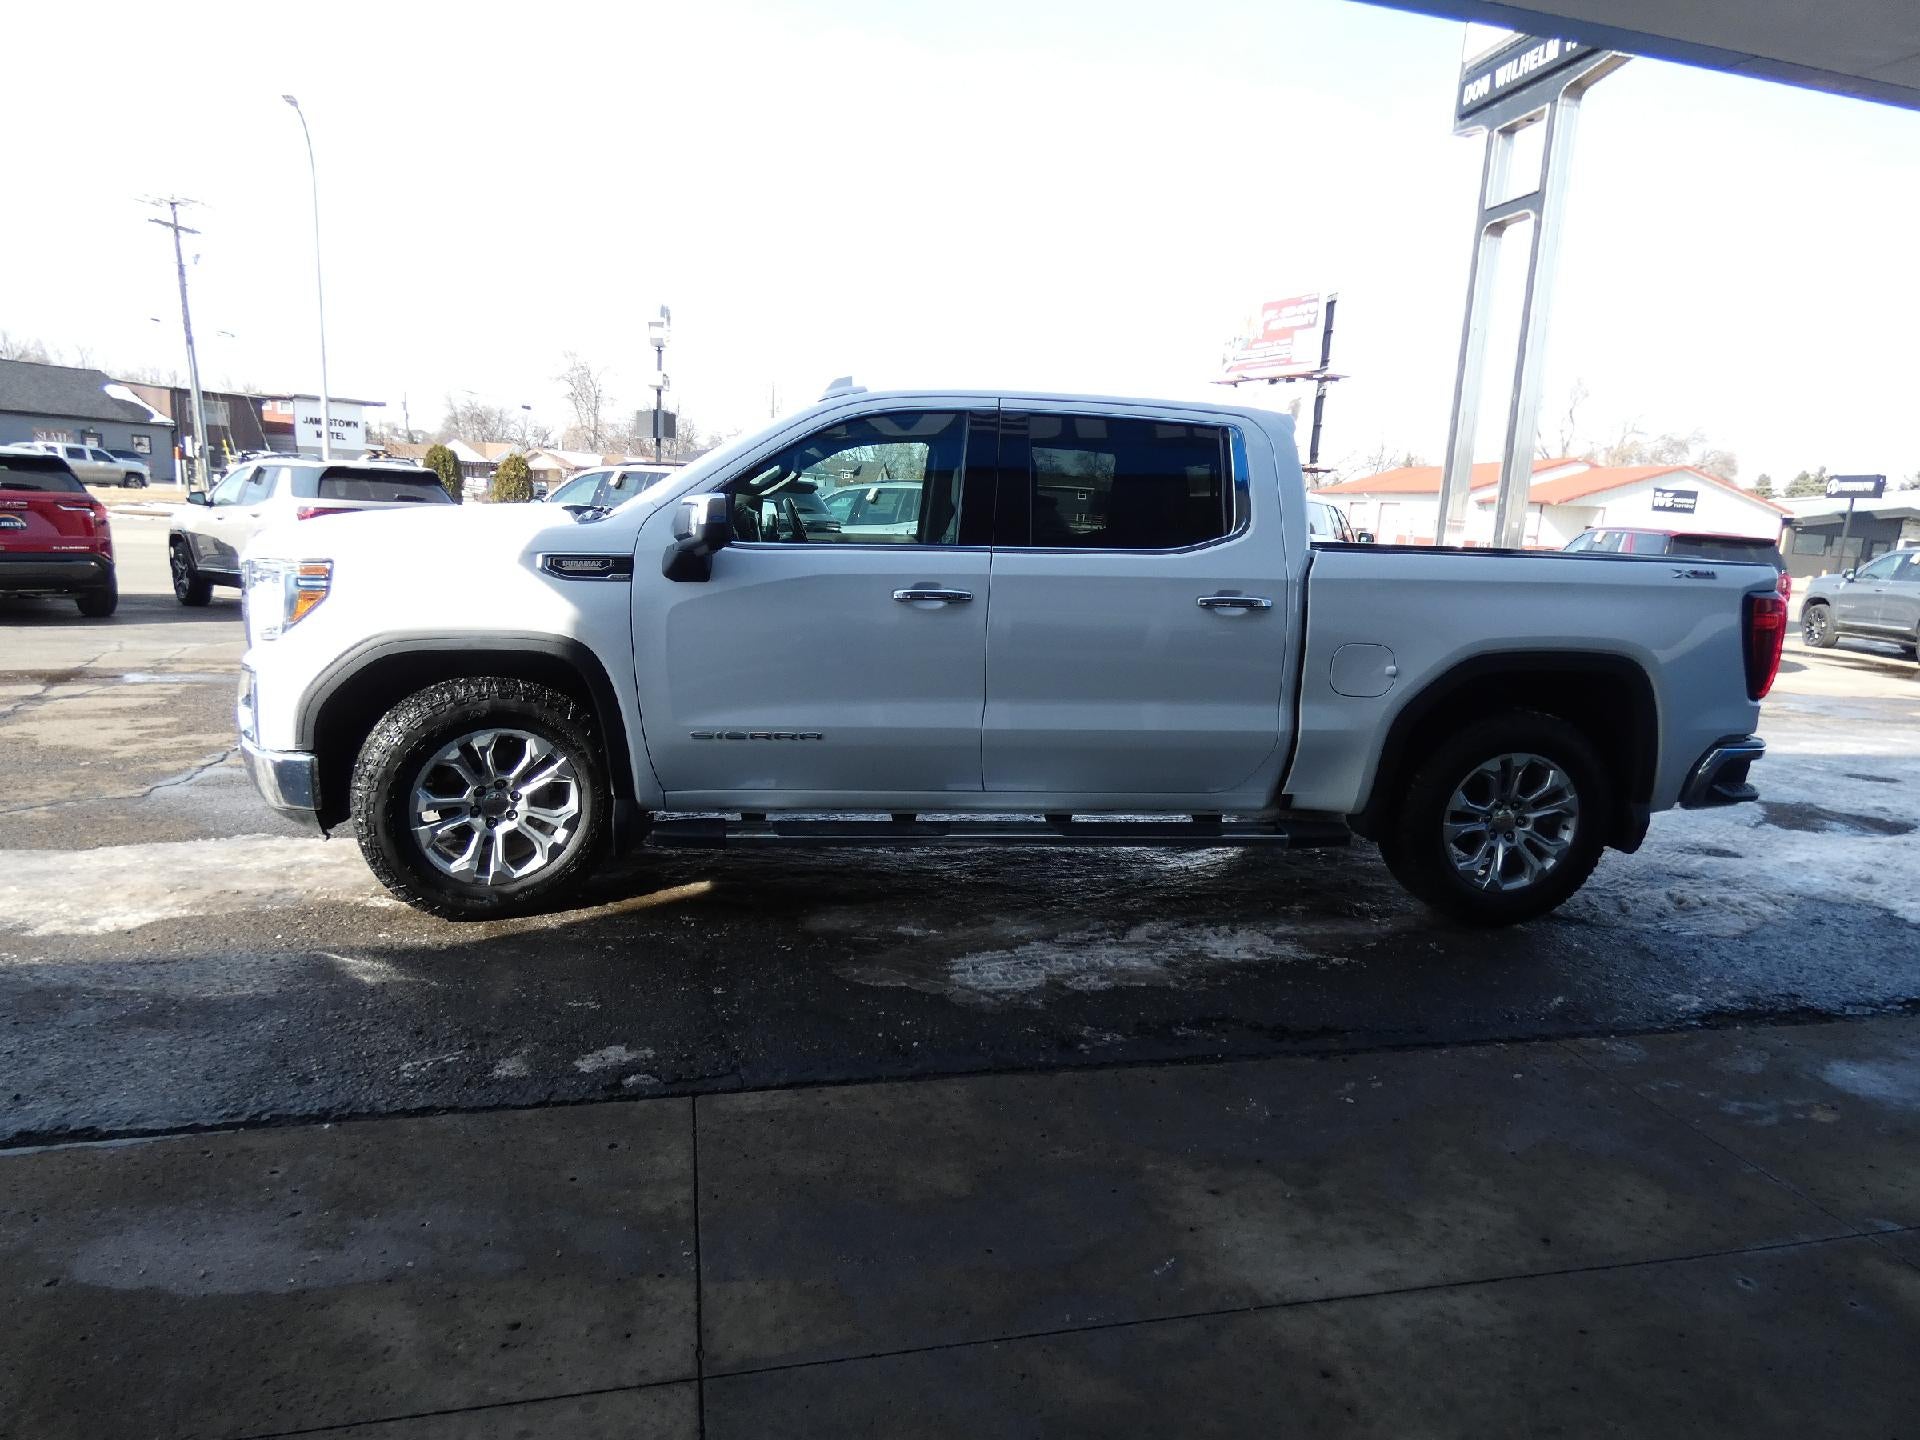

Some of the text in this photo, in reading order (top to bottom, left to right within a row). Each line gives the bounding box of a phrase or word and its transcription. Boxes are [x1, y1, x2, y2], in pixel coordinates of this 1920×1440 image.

[1463, 39, 1561, 106] DON WILHELM
[302, 416, 359, 429] JAMSTOWN
[316, 430, 346, 440] MTEL
[690, 731, 823, 740] SIERRA
